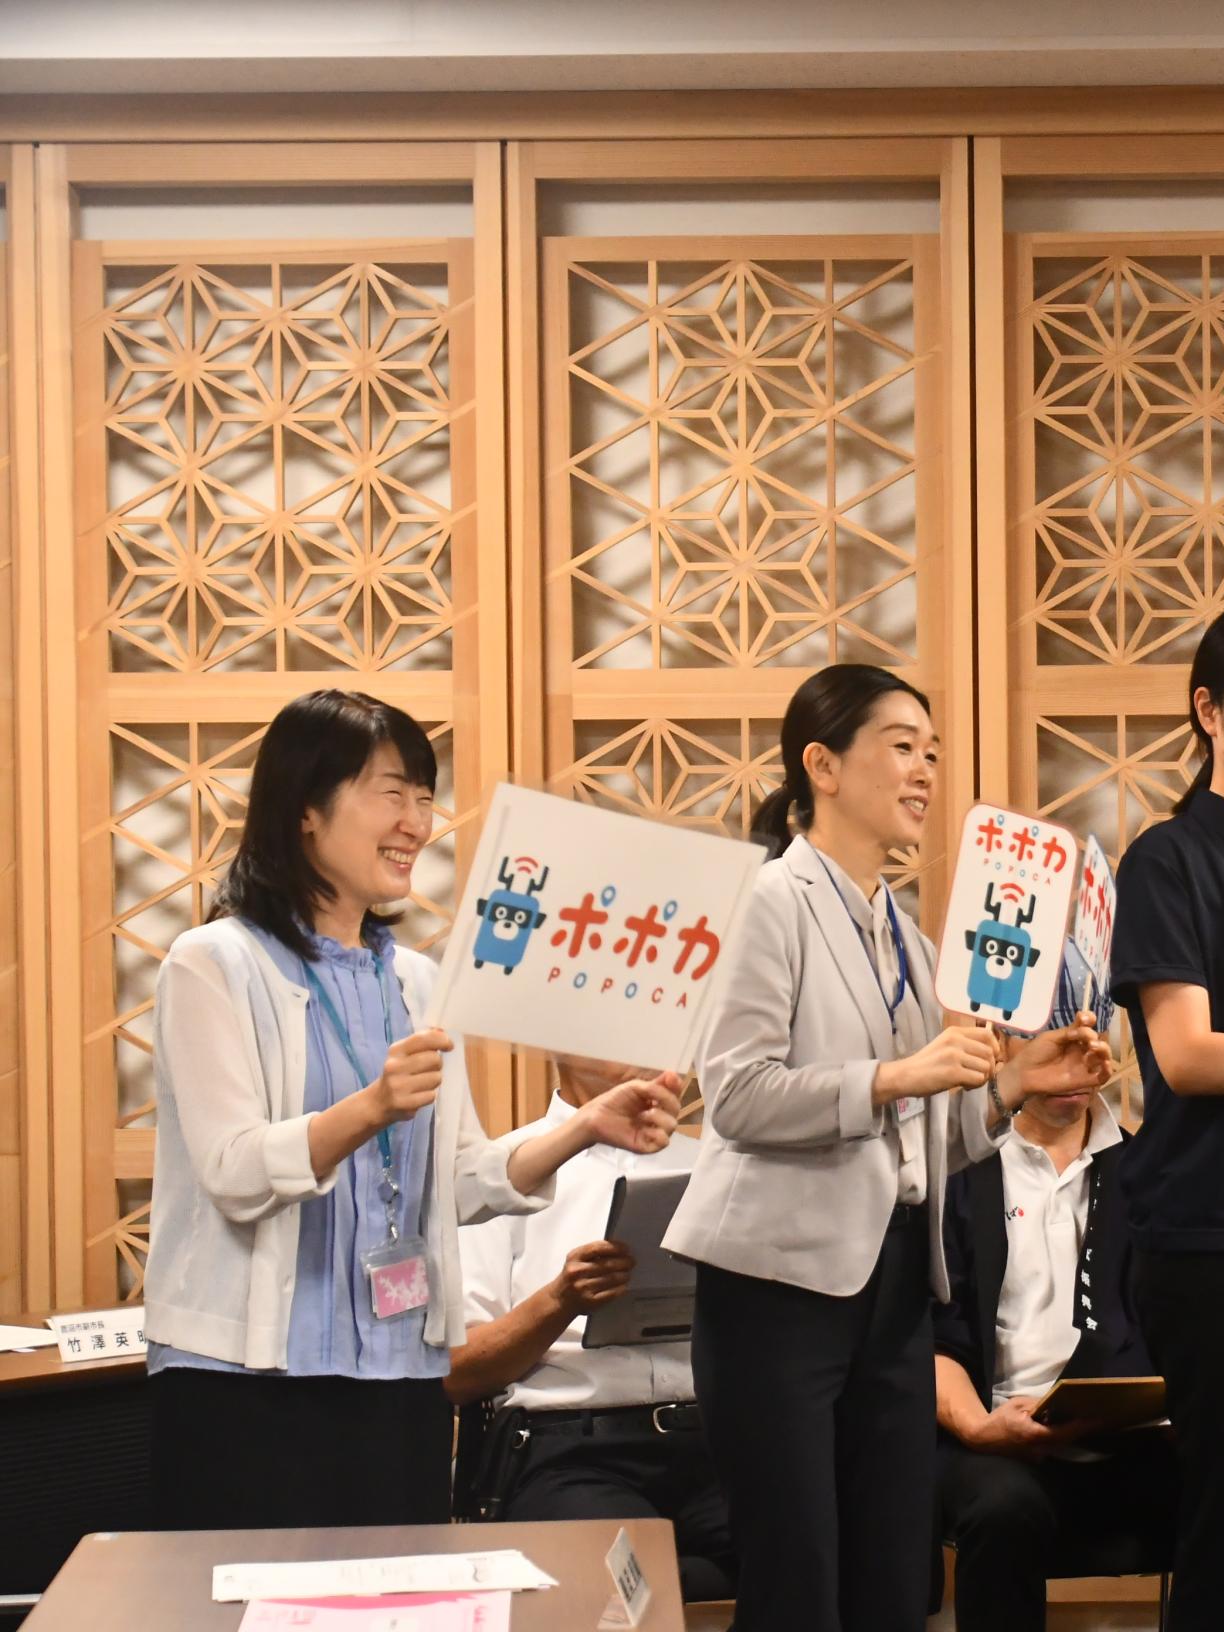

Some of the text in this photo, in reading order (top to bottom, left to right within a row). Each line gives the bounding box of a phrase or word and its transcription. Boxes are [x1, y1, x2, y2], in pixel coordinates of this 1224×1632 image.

[975, 814, 1067, 873] ポポカ
[983, 858, 1052, 885] POPOCA
[551, 885, 720, 981] ポポカ
[548, 967, 687, 1008] POPOCA
